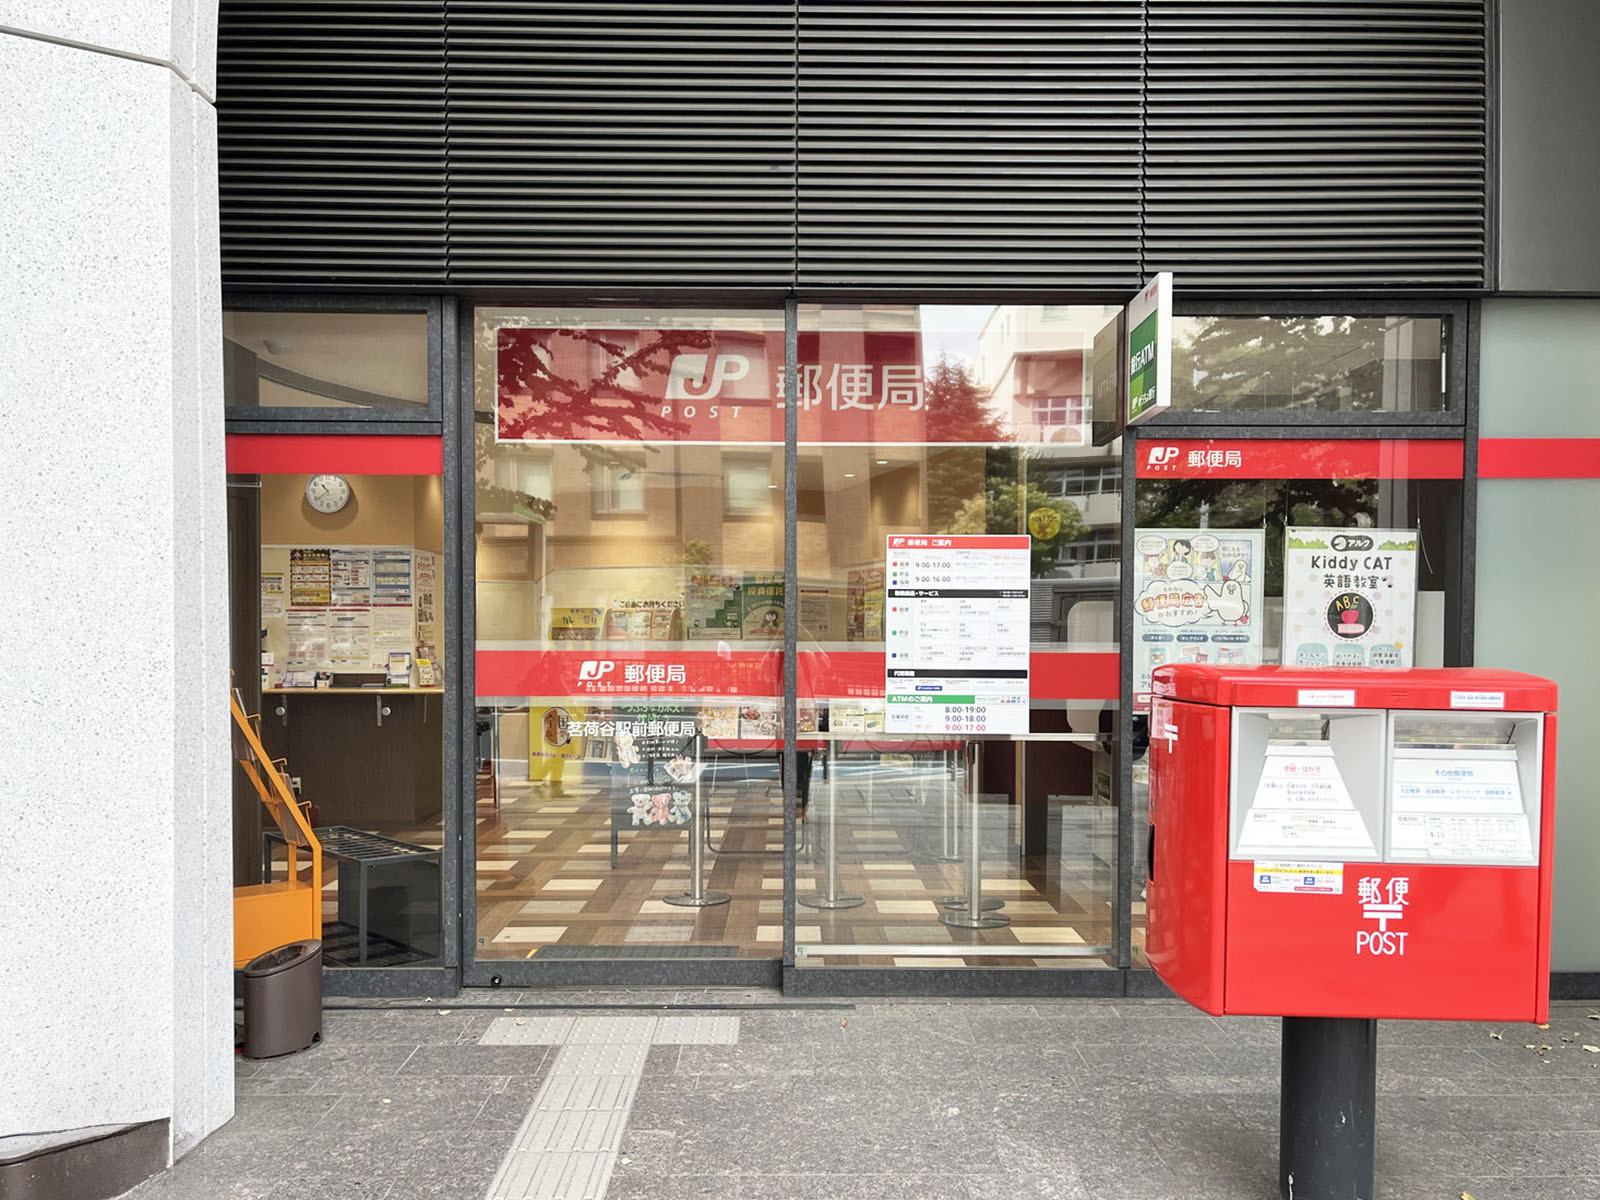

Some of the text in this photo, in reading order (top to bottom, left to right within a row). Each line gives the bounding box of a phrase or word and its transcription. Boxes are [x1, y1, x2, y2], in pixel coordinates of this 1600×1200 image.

[776, 363, 926, 412] 郵便局
[660, 405, 744, 419] POST
[1187, 450, 1242, 468] 郵便局
[1347, 539, 1370, 548] アルク
[1311, 555, 1392, 571] Kiddy CAT
[1323, 574, 1380, 589] 英語教室
[624, 664, 686, 685] 郵便局
[567, 720, 697, 738] 茗荷谷駅前郵便局
[1357, 876, 1410, 906] 郵便
[1356, 931, 1409, 956] POST
